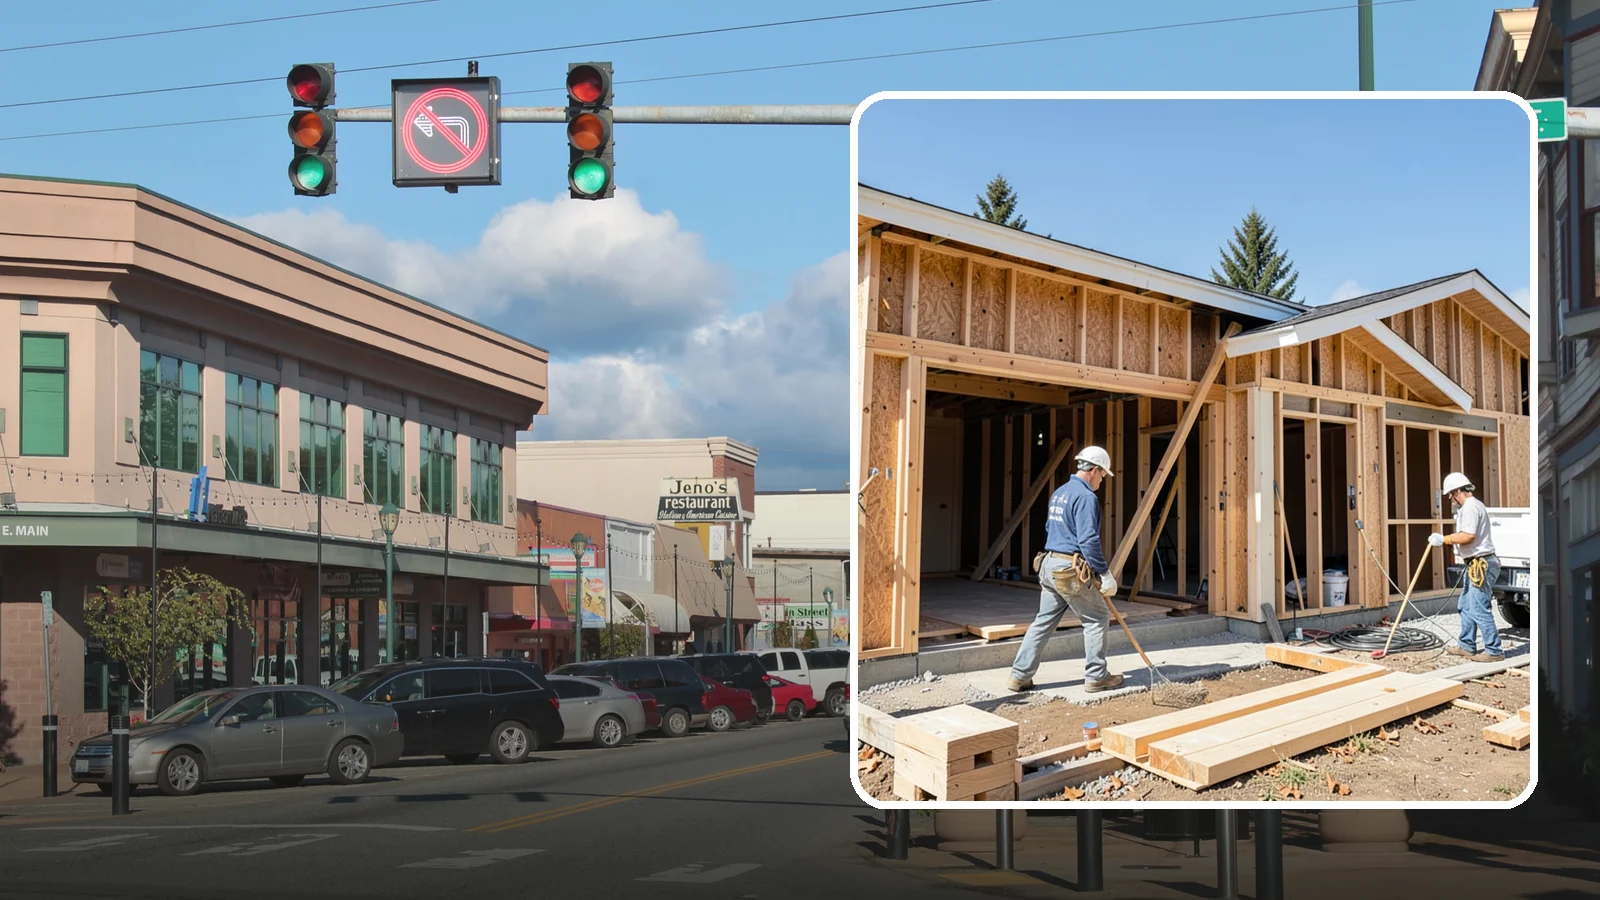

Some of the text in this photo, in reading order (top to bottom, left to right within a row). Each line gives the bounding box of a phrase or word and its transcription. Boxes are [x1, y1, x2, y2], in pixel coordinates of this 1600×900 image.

[670, 480, 727, 494] Jeno's
[665, 497, 730, 508] restaurant
[686, 510, 714, 519] American
[715, 509, 737, 518] Cuisine
[2, 525, 49, 536] E. MAIN
[785, 608, 795, 616] in
[797, 607, 828, 616] Street
